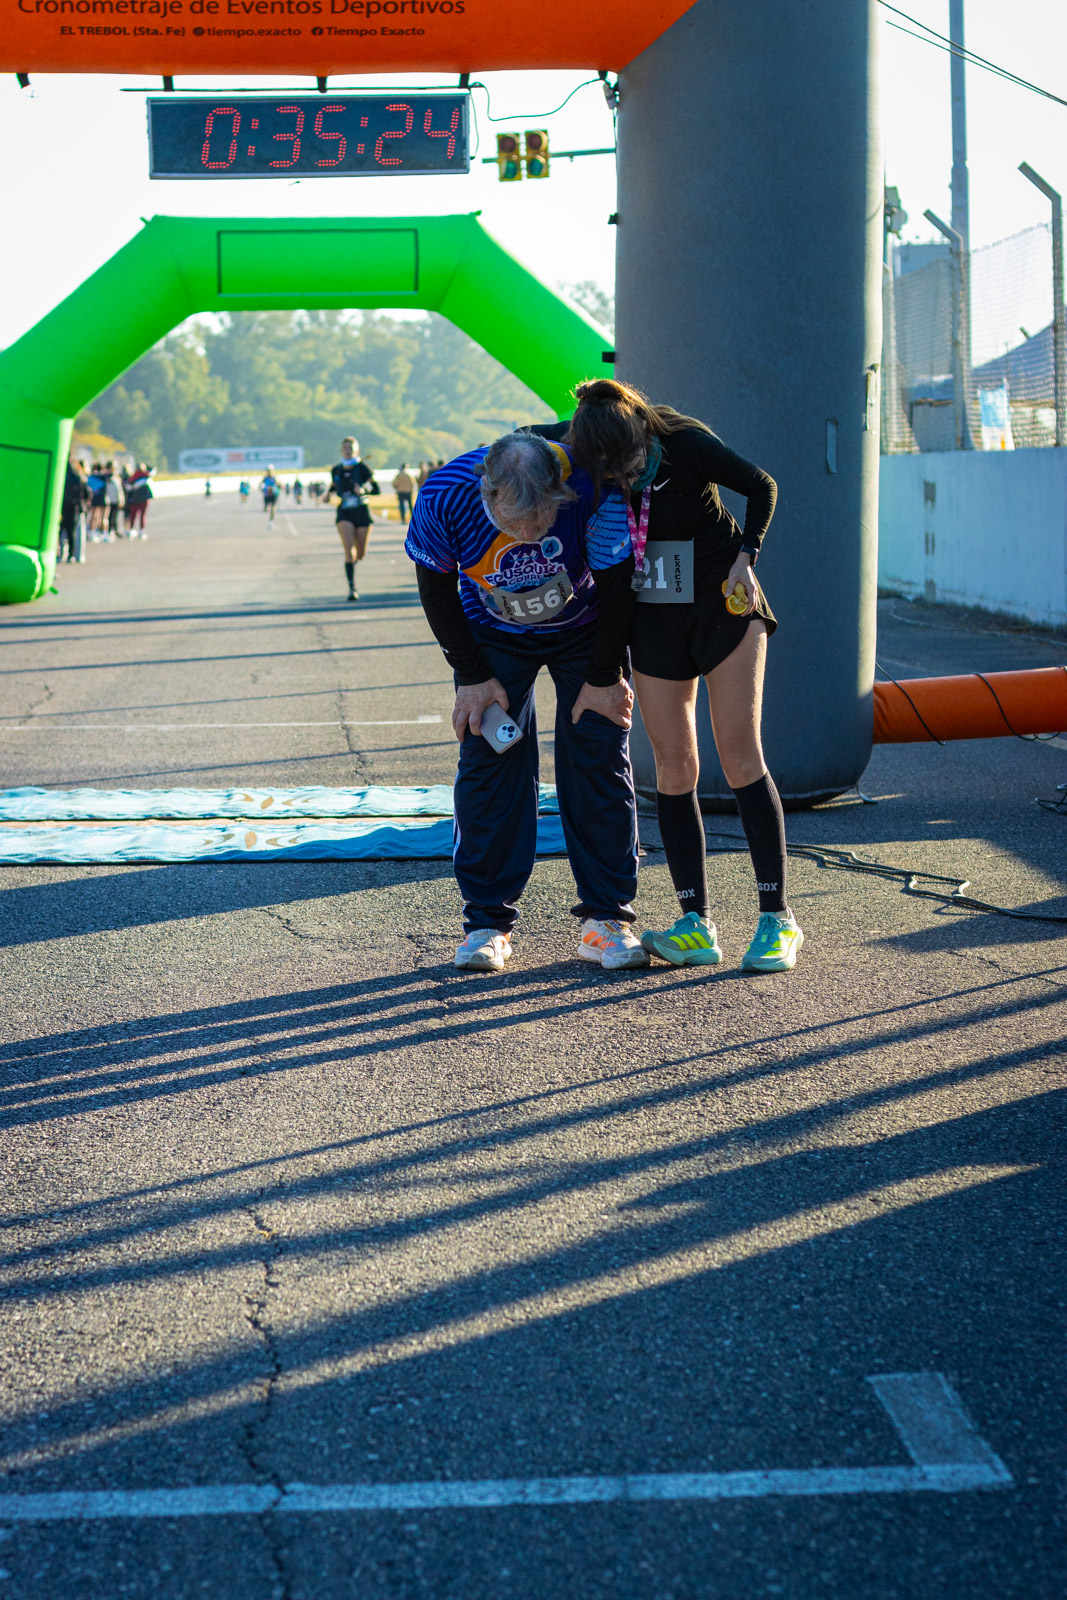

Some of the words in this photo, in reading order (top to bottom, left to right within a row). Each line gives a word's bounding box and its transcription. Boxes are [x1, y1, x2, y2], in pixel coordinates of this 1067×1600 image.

[18, 0, 183, 18] Cronometraje
[190, 0, 219, 14] de
[228, 0, 322, 14] Eventos
[331, 0, 465, 18] Deportivos
[60, 26, 75, 36] EL
[78, 26, 130, 36] TREBOL
[133, 26, 163, 37] (Sta.
[166, 26, 185, 37] Fe)
[207, 27, 302, 38] tiempo.exacto
[326, 26, 377, 38] Tiempo
[381, 27, 425, 36] Exacto
[201, 104, 459, 169] 0:35:24
[674, 554, 682, 593] EXACTO
[509, 574, 542, 585] CORRE
[510, 589, 561, 617] 156
[757, 882, 778, 891] SOX
[676, 889, 695, 900] SOX
